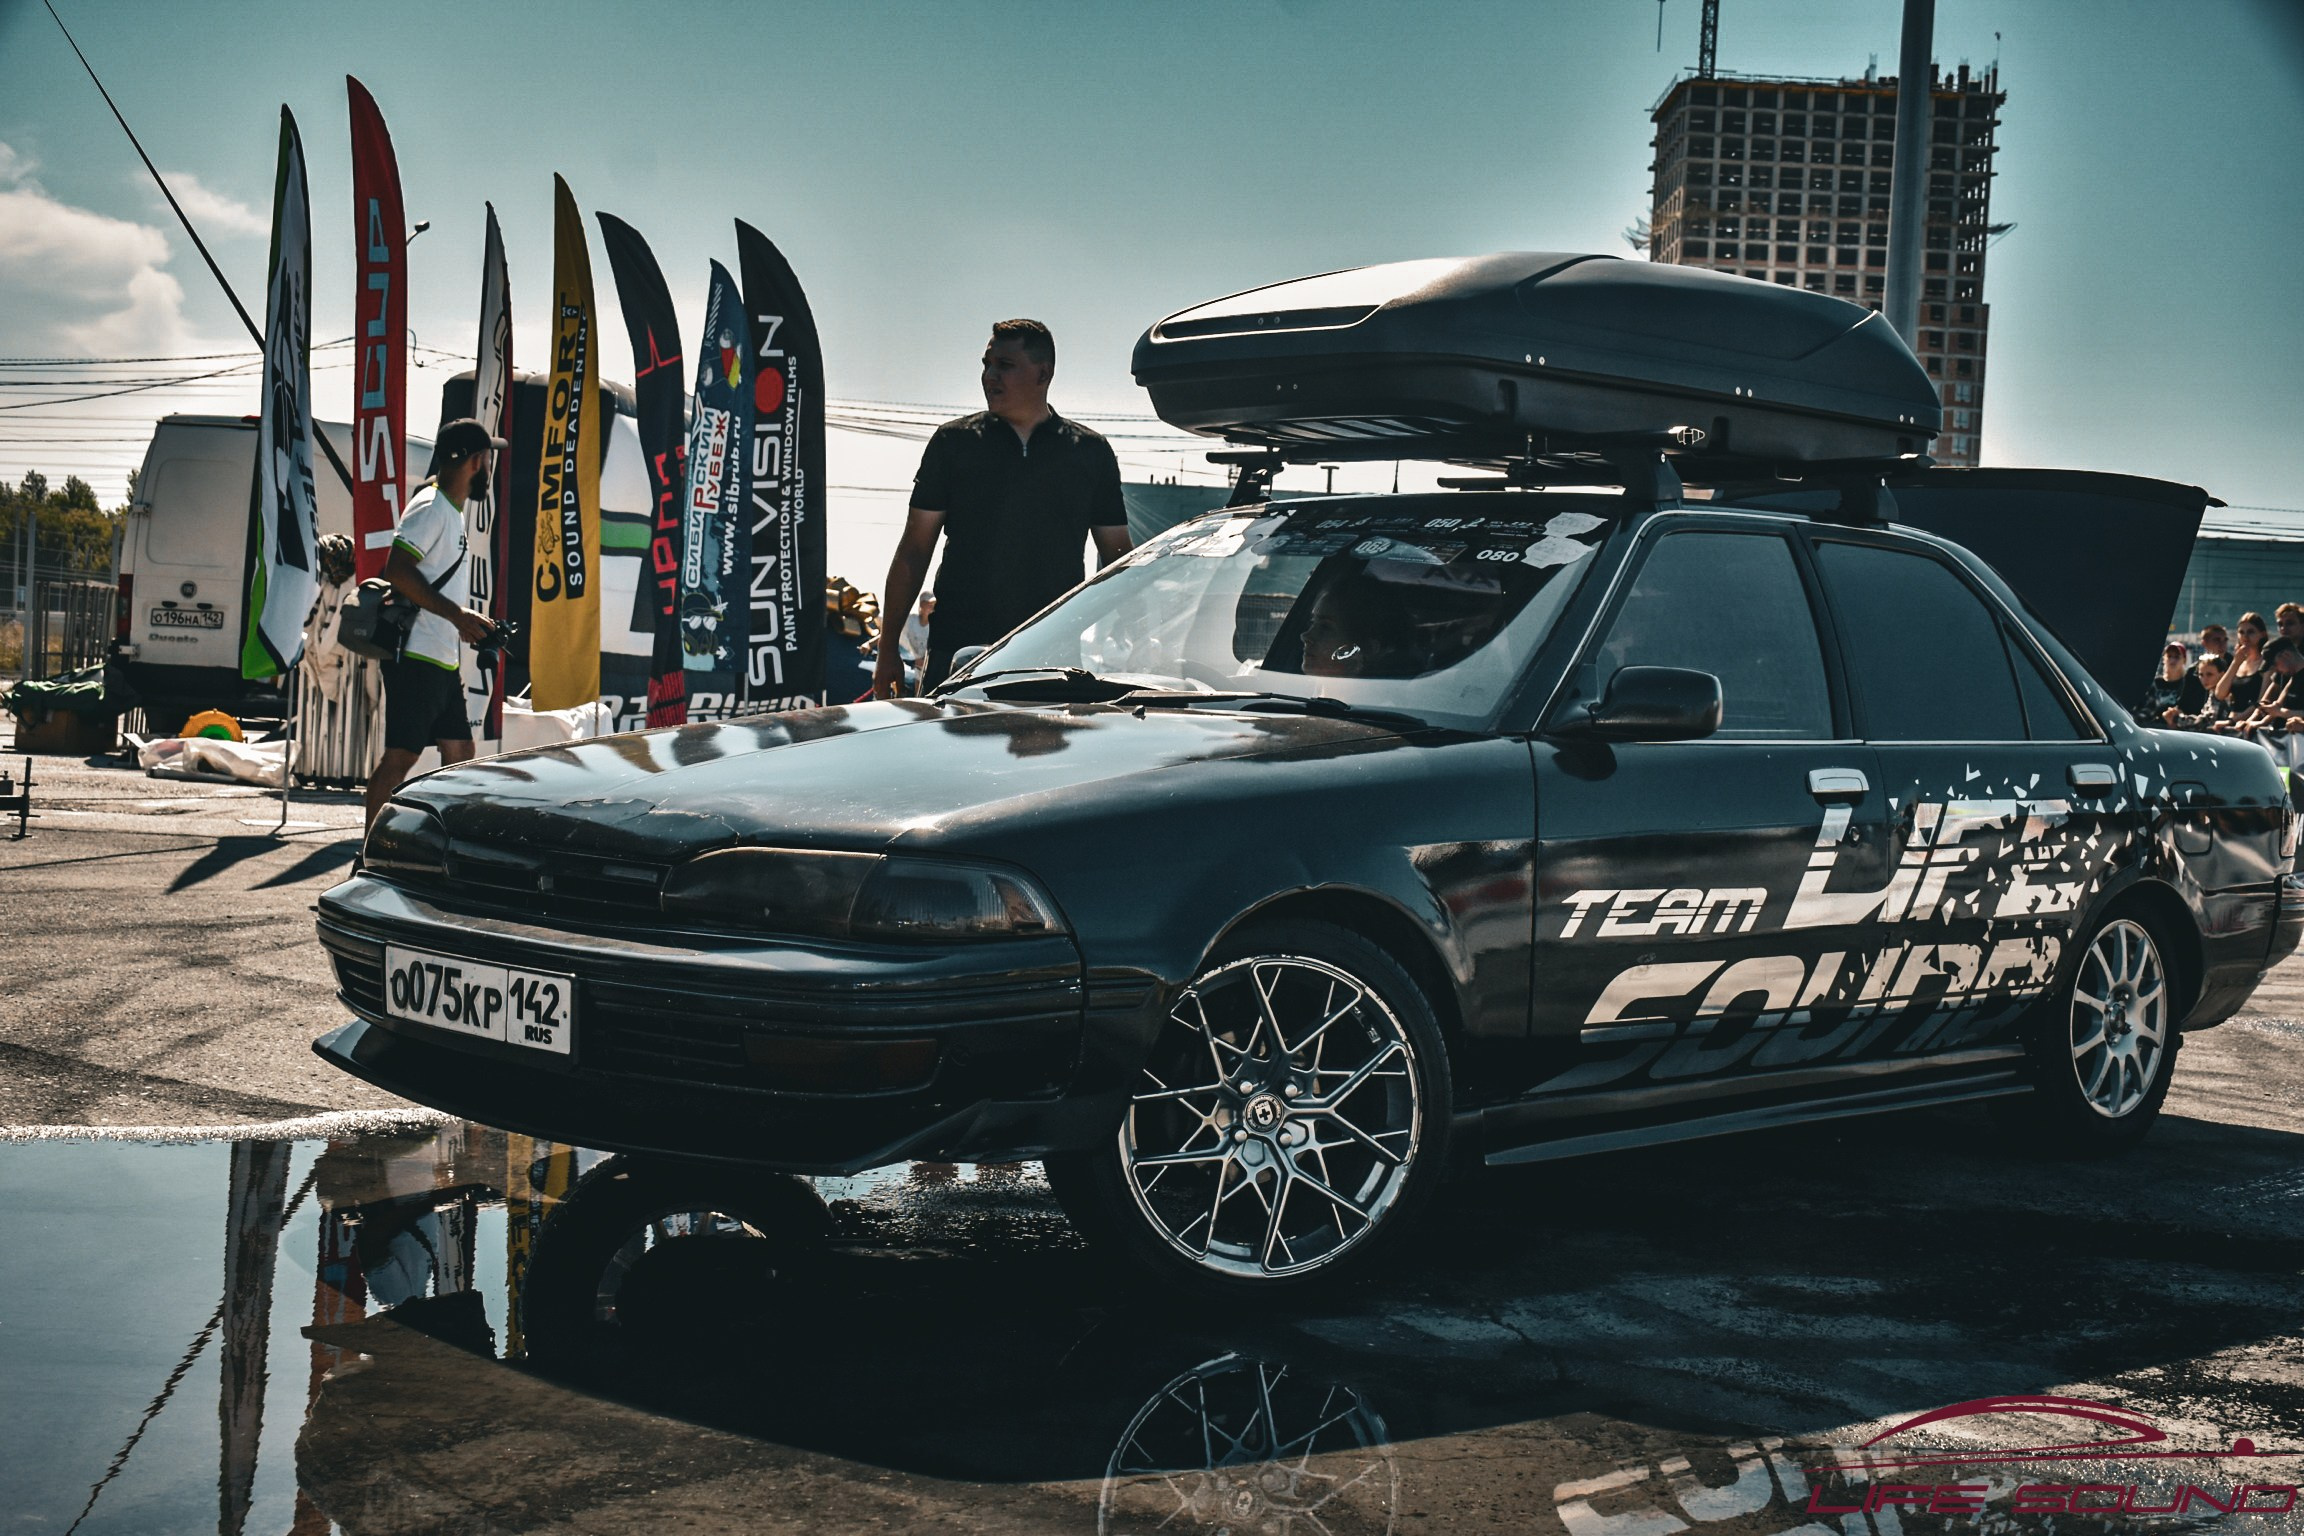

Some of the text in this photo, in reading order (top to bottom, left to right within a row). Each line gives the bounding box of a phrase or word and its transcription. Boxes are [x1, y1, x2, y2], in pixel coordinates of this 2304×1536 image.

[535, 292, 580, 603] CMFORT
[720, 415, 742, 576] www.sibrub.ru
[780, 355, 798, 652] PAINT PROTECTION & WINDOW FILMS
[793, 467, 805, 524] WORLD
[563, 491, 584, 587] SOUND
[1476, 549, 1520, 563] 080
[748, 554, 784, 686] SUN
[1559, 887, 1768, 938] TEAM
[509, 977, 560, 1028] 142
[524, 1024, 553, 1045] RUS
